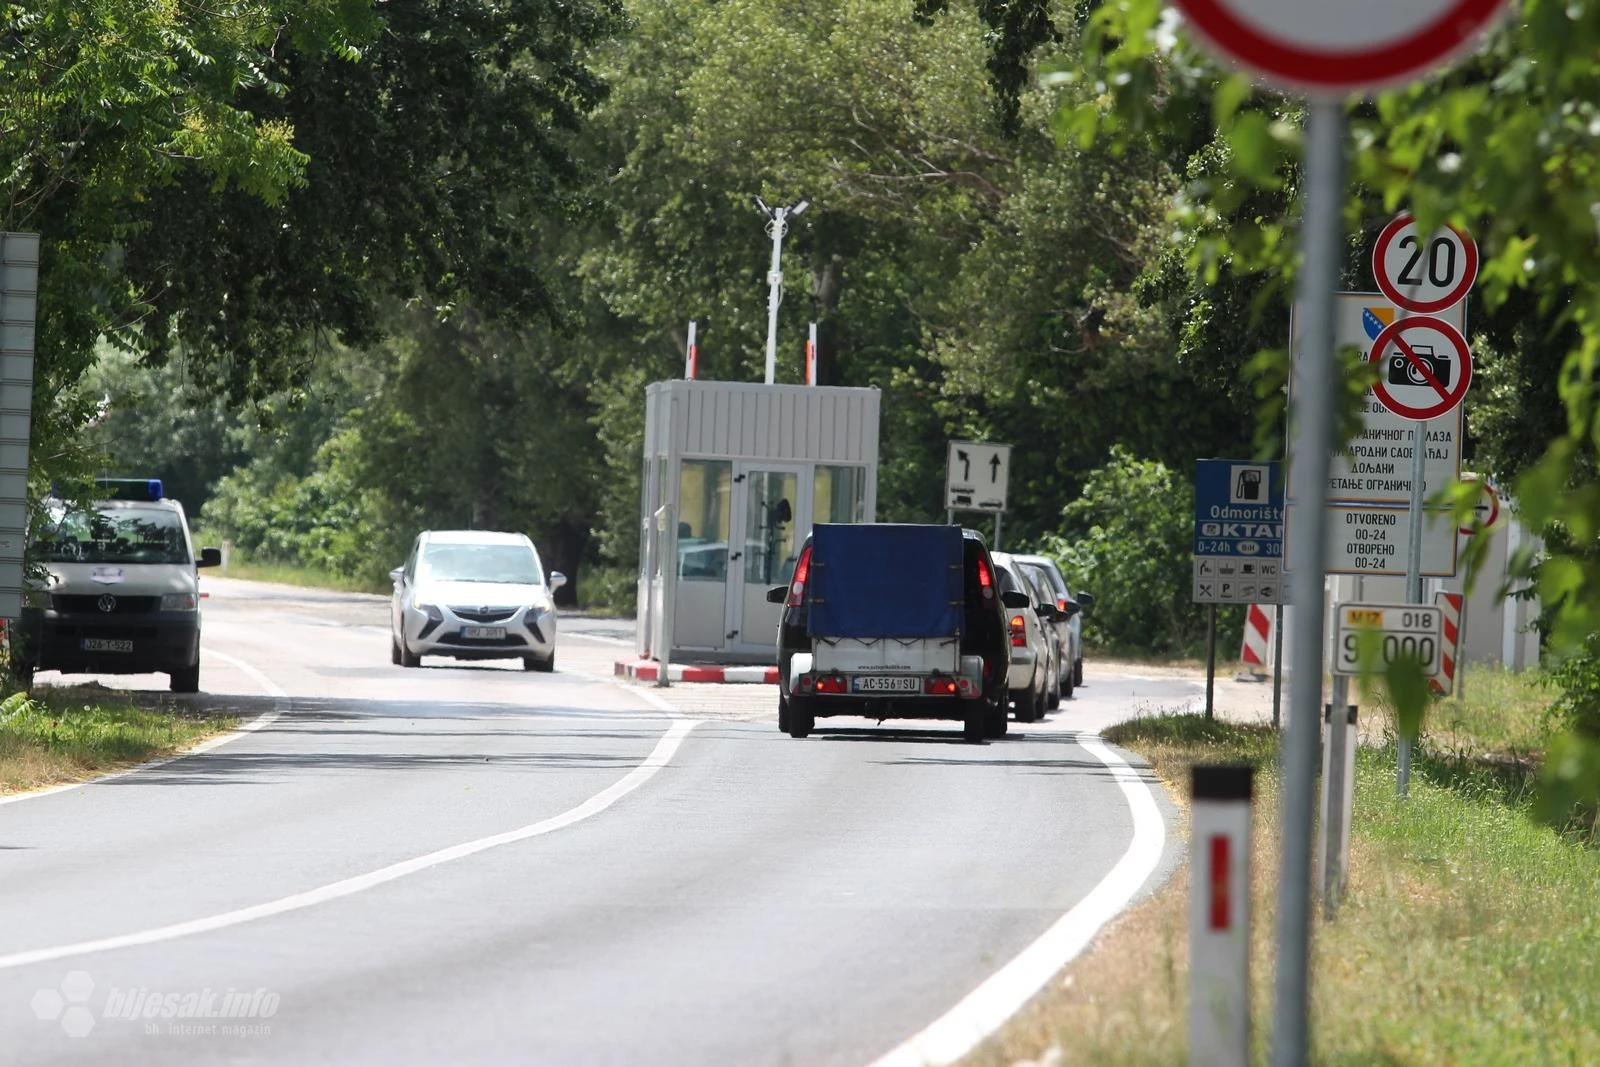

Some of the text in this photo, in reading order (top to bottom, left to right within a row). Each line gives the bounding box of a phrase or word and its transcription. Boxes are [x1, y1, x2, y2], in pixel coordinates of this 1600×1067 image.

[1397, 235, 1456, 288] 20
[1351, 428, 1452, 442] АНИЧНОГ ПЛАЗА
[1351, 462, 1395, 475] ДОЉАНИ
[1346, 513, 1396, 526] OTVORENO
[1355, 529, 1386, 541] 00-24
[1266, 543, 1283, 555] 30
[1346, 543, 1395, 556] ОТВОРЕНО
[1354, 557, 1386, 569] 00-24
[1261, 565, 1276, 575] WC
[1403, 612, 1432, 628] 018
[903, 678, 915, 690] SU
